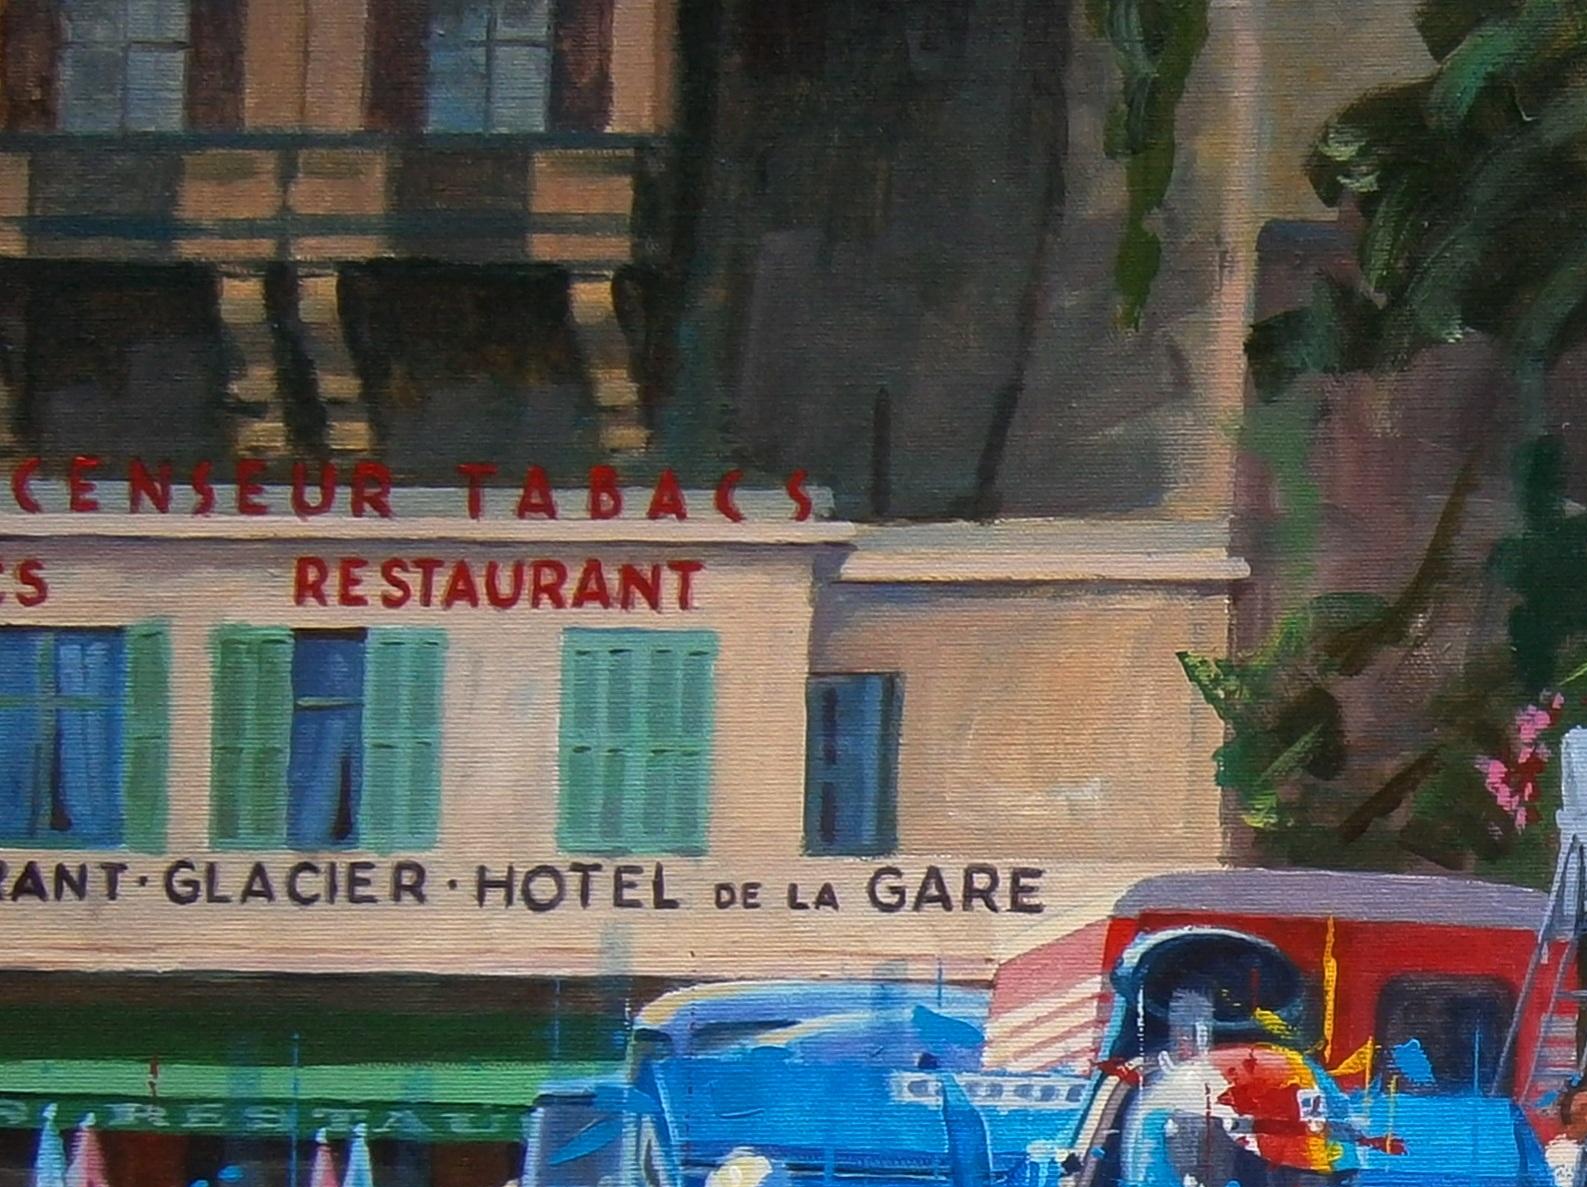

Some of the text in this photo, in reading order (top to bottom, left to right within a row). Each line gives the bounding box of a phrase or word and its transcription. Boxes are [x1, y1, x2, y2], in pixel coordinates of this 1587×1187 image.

[11, 454, 813, 523] CENSEUR TABACS
[0, 559, 48, 608] S
[292, 556, 706, 611] RESTAURANT
[164, 858, 428, 906] GLACIER
[474, 862, 680, 912] HOTEL
[714, 881, 762, 910] DE
[786, 882, 840, 912] LA
[867, 864, 1047, 914] GARE
